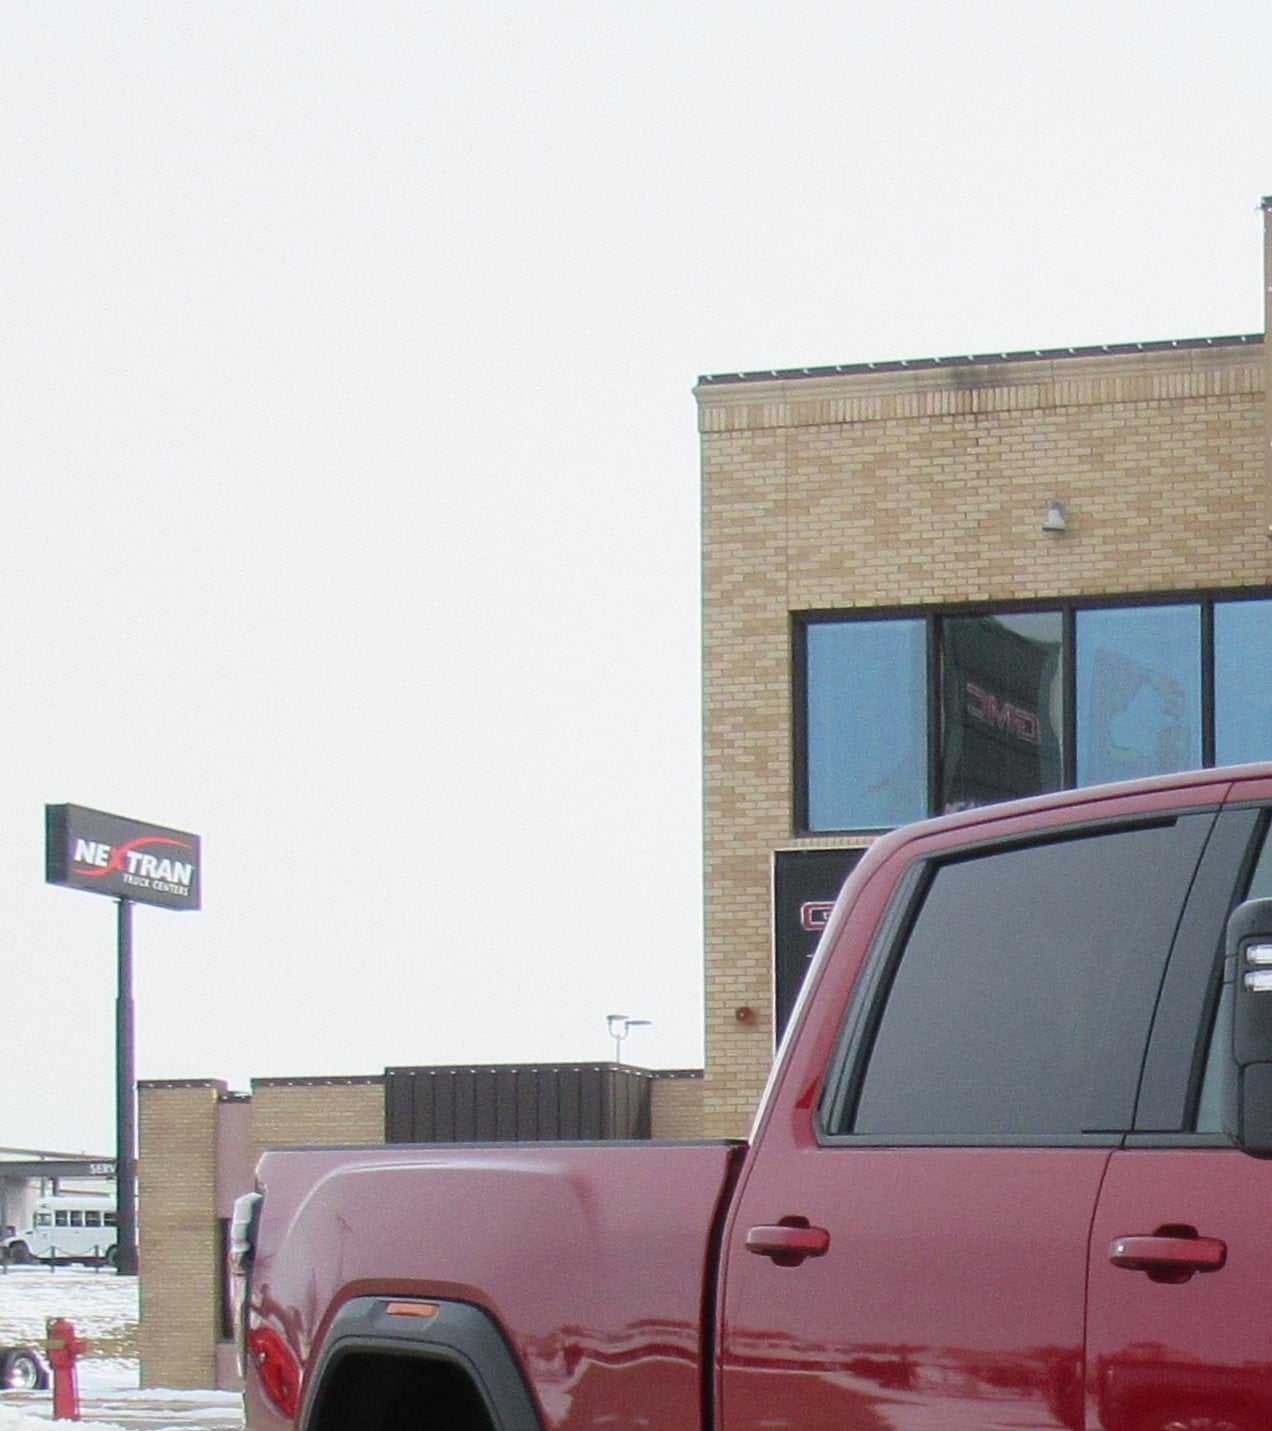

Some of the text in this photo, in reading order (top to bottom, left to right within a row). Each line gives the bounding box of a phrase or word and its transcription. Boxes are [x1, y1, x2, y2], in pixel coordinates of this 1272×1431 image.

[73, 838, 194, 886] NEXTRAN
[123, 873, 189, 896] TRUCK CENTERS
